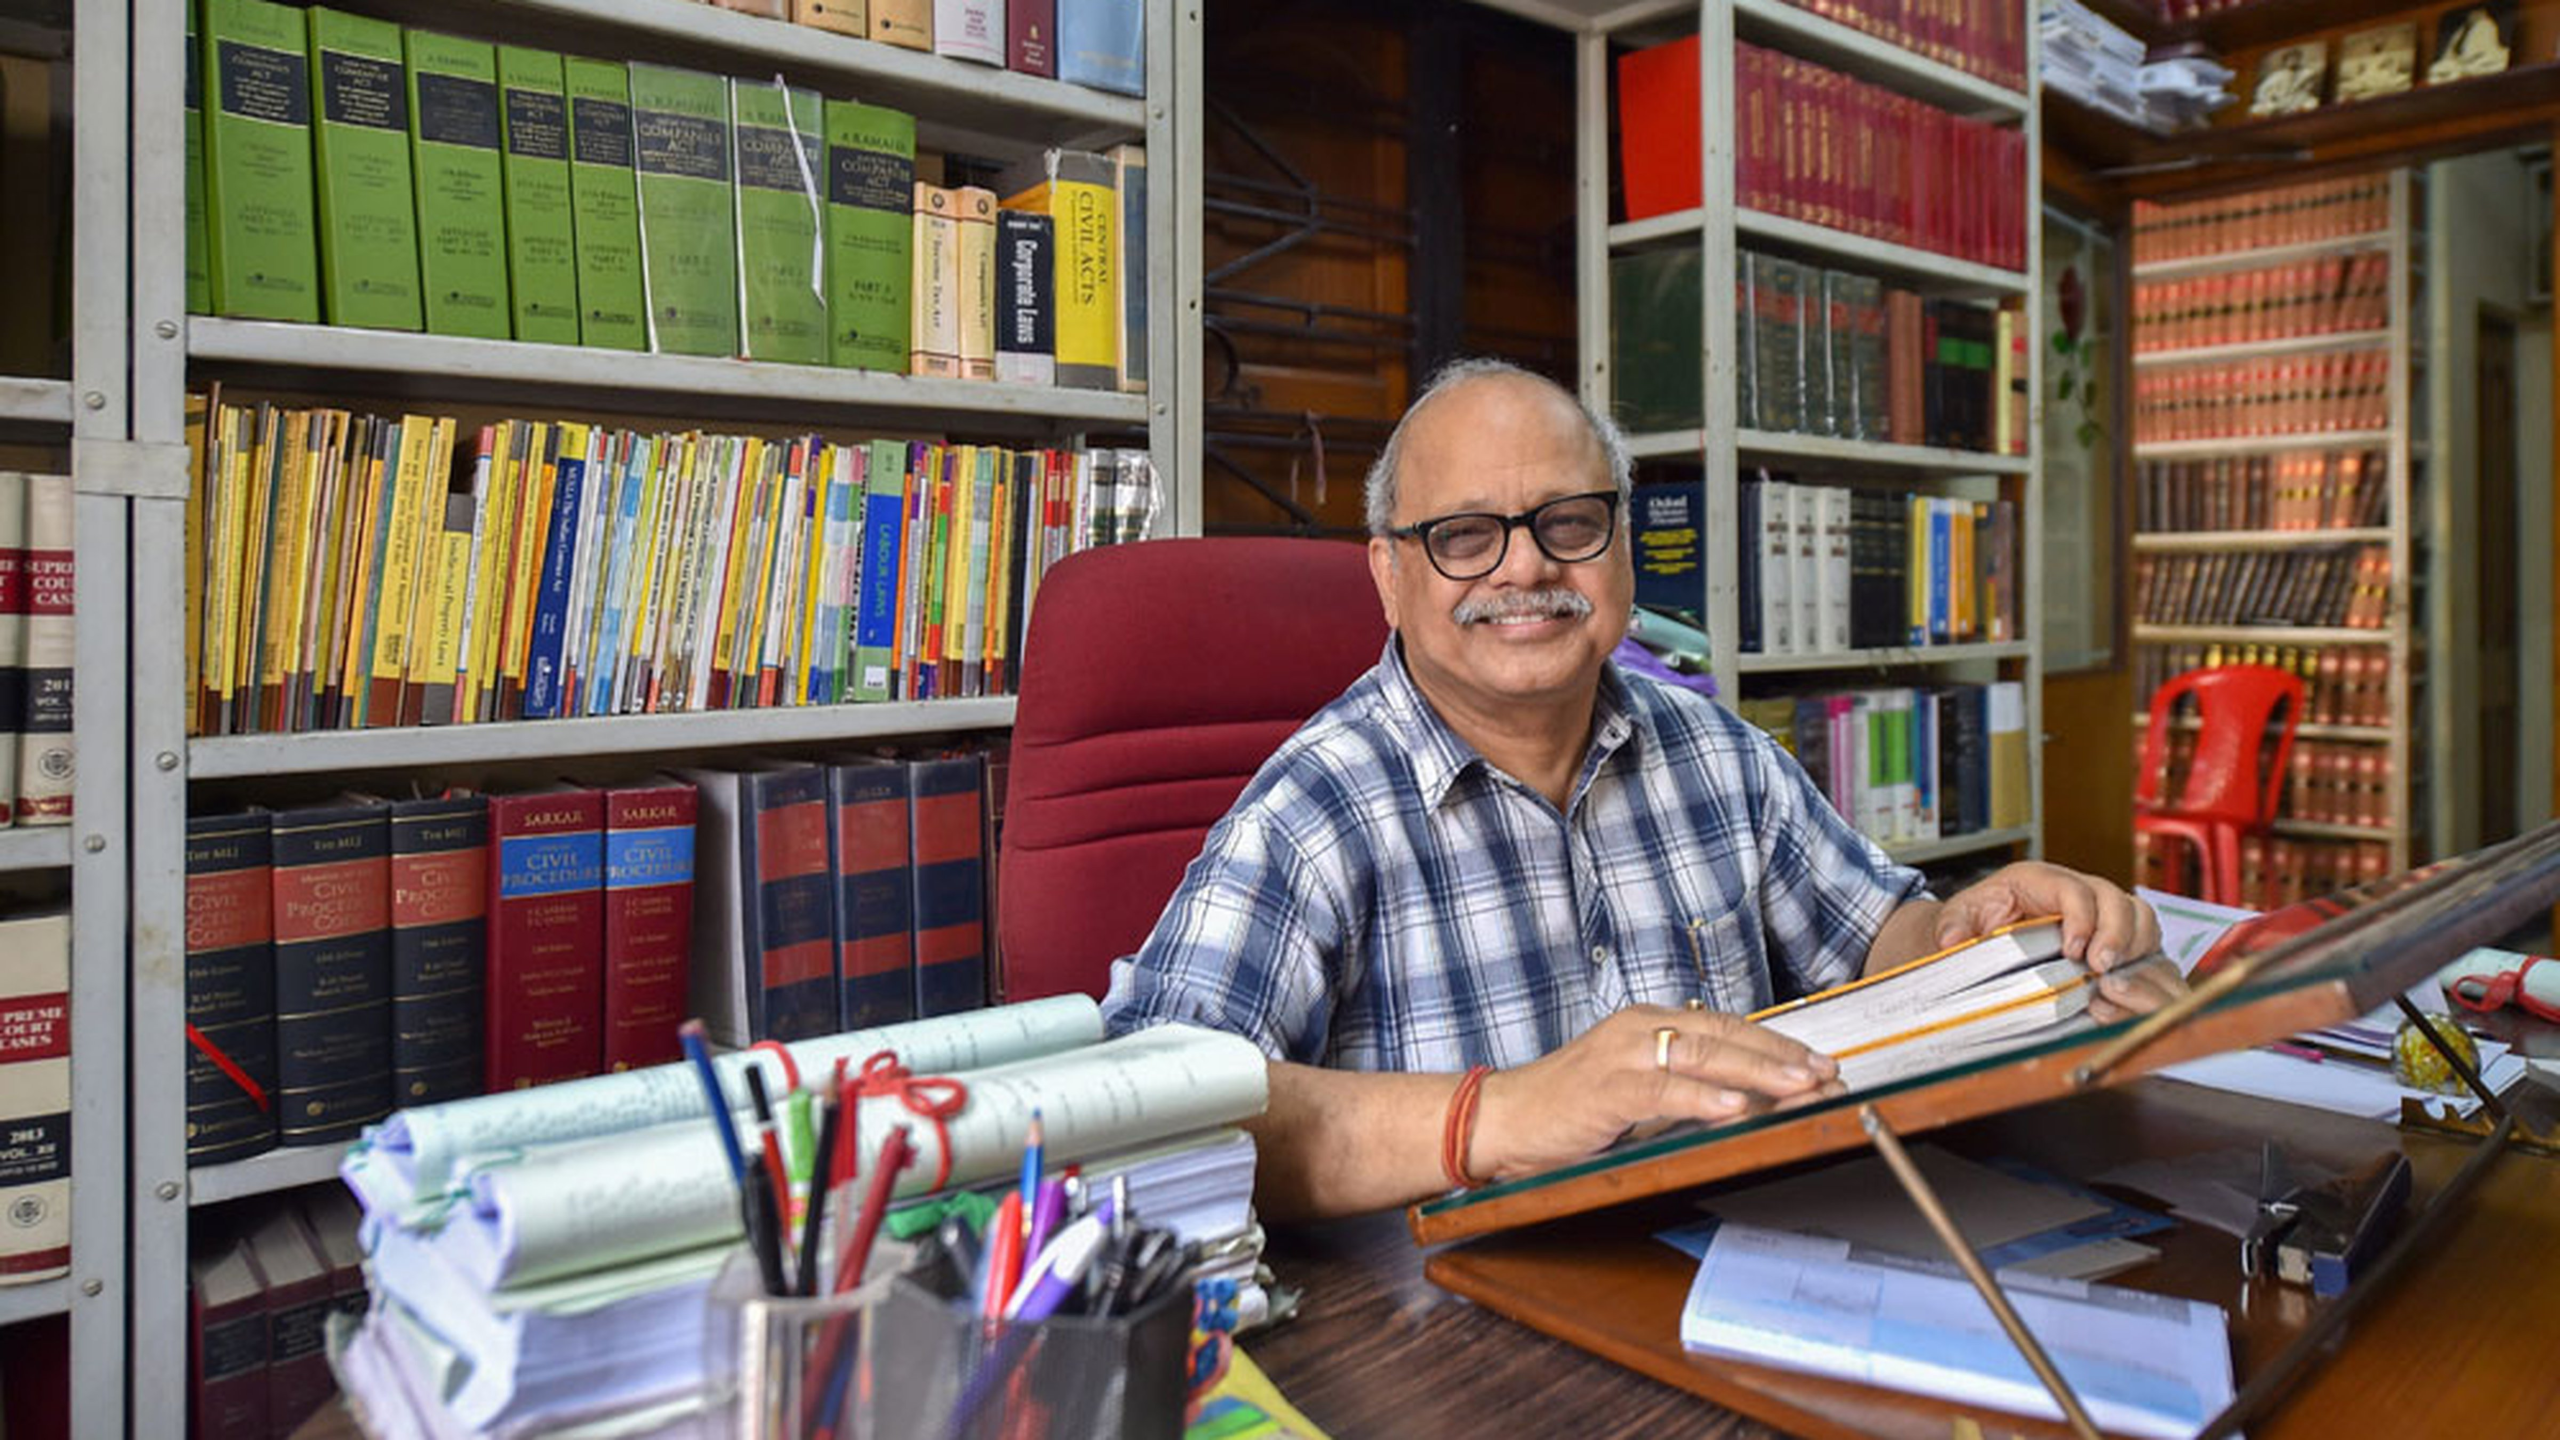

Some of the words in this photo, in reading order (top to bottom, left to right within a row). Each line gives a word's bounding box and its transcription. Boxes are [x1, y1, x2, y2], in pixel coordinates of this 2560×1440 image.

[639, 124, 722, 147] COMPANIES
[667, 138, 697, 153] ACT
[841, 160, 911, 182] COMPANIES
[866, 177, 891, 189] ACT
[1079, 191, 1095, 243] CIVIL
[1097, 213, 1107, 284] CENTRAL
[1012, 240, 1039, 306] Corporate
[1081, 251, 1096, 307] ACTS
[1016, 308, 1039, 344] Laws
[1649, 495, 1687, 508] Oxford
[877, 524, 892, 578] LABOUR
[875, 581, 888, 618] LAWS
[523, 810, 585, 828] SARKAR
[621, 806, 678, 823] SARKAR
[525, 853, 580, 871] CIVIL
[623, 847, 675, 864] CIVIL
